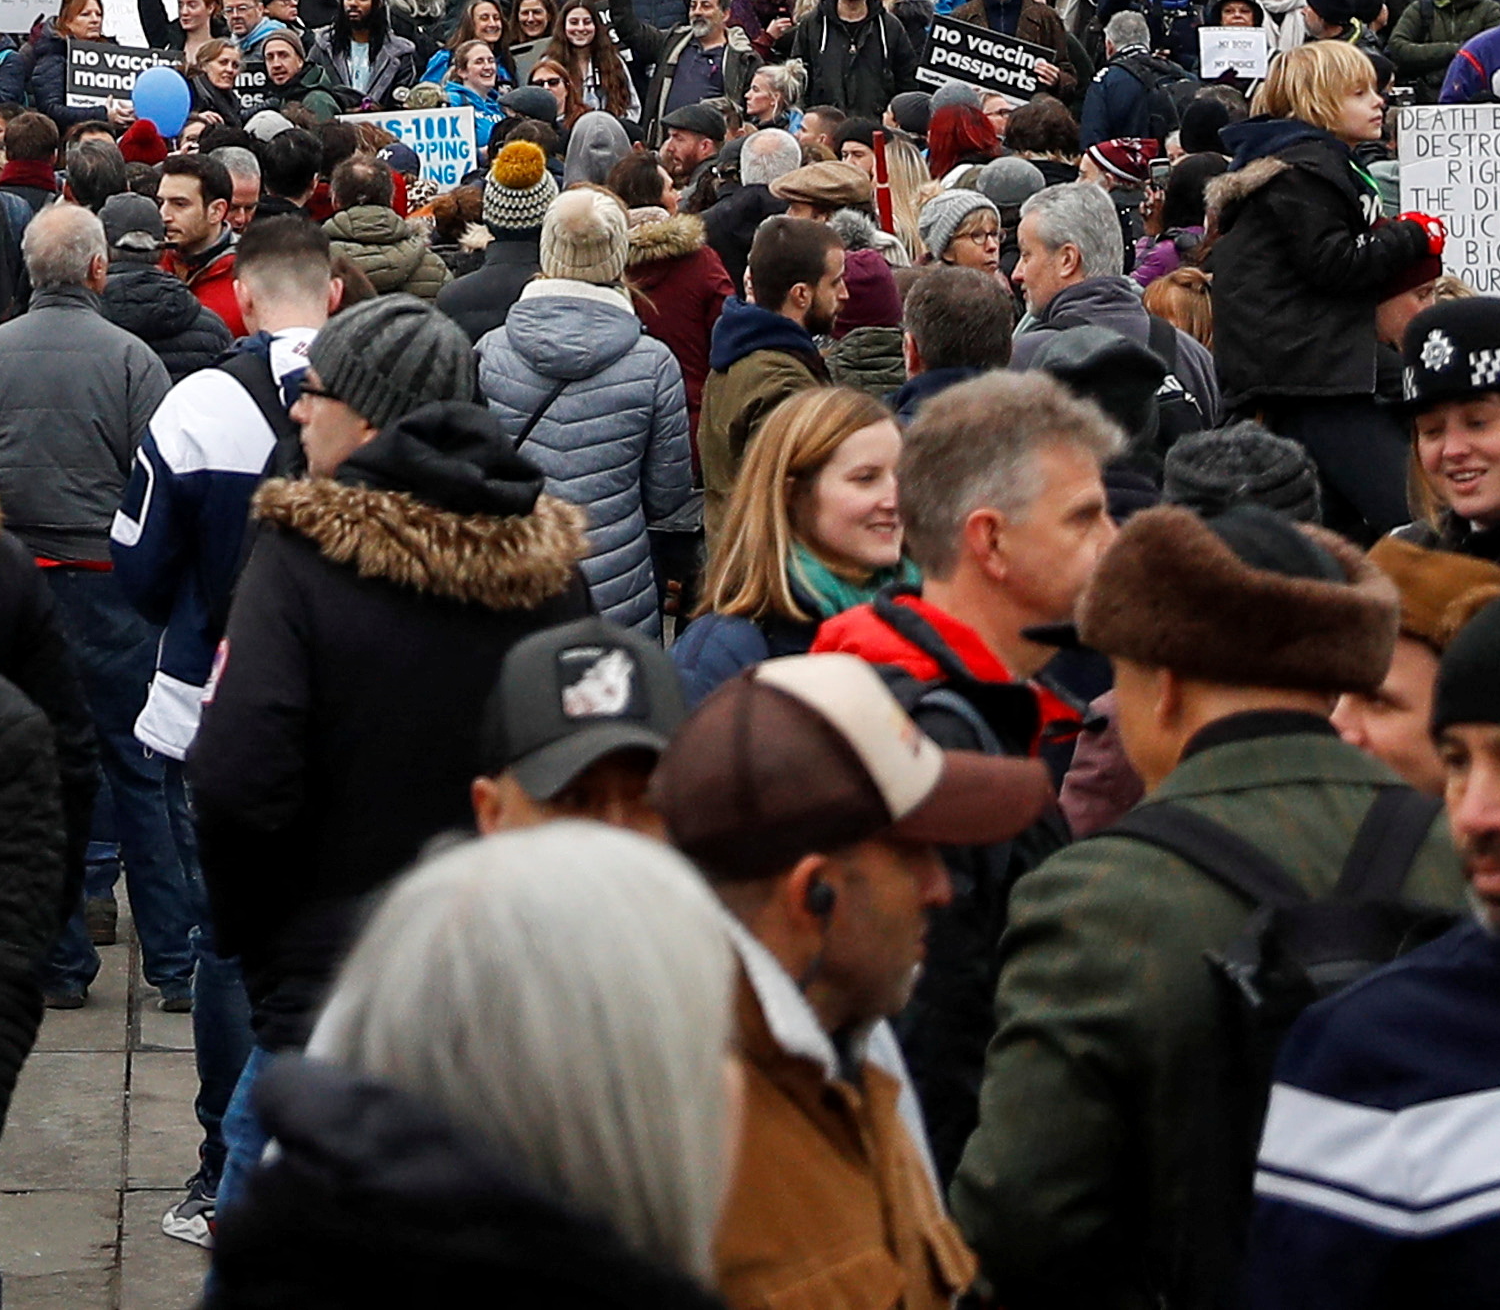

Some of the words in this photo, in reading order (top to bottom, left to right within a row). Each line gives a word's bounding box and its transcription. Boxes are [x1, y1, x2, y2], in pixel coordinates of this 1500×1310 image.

[932, 24, 961, 46] no
[72, 48, 99, 66] no
[74, 70, 136, 91] mand
[930, 46, 1038, 92] passports
[1401, 107, 1477, 131] DEATH
[1410, 187, 1456, 211] THE
